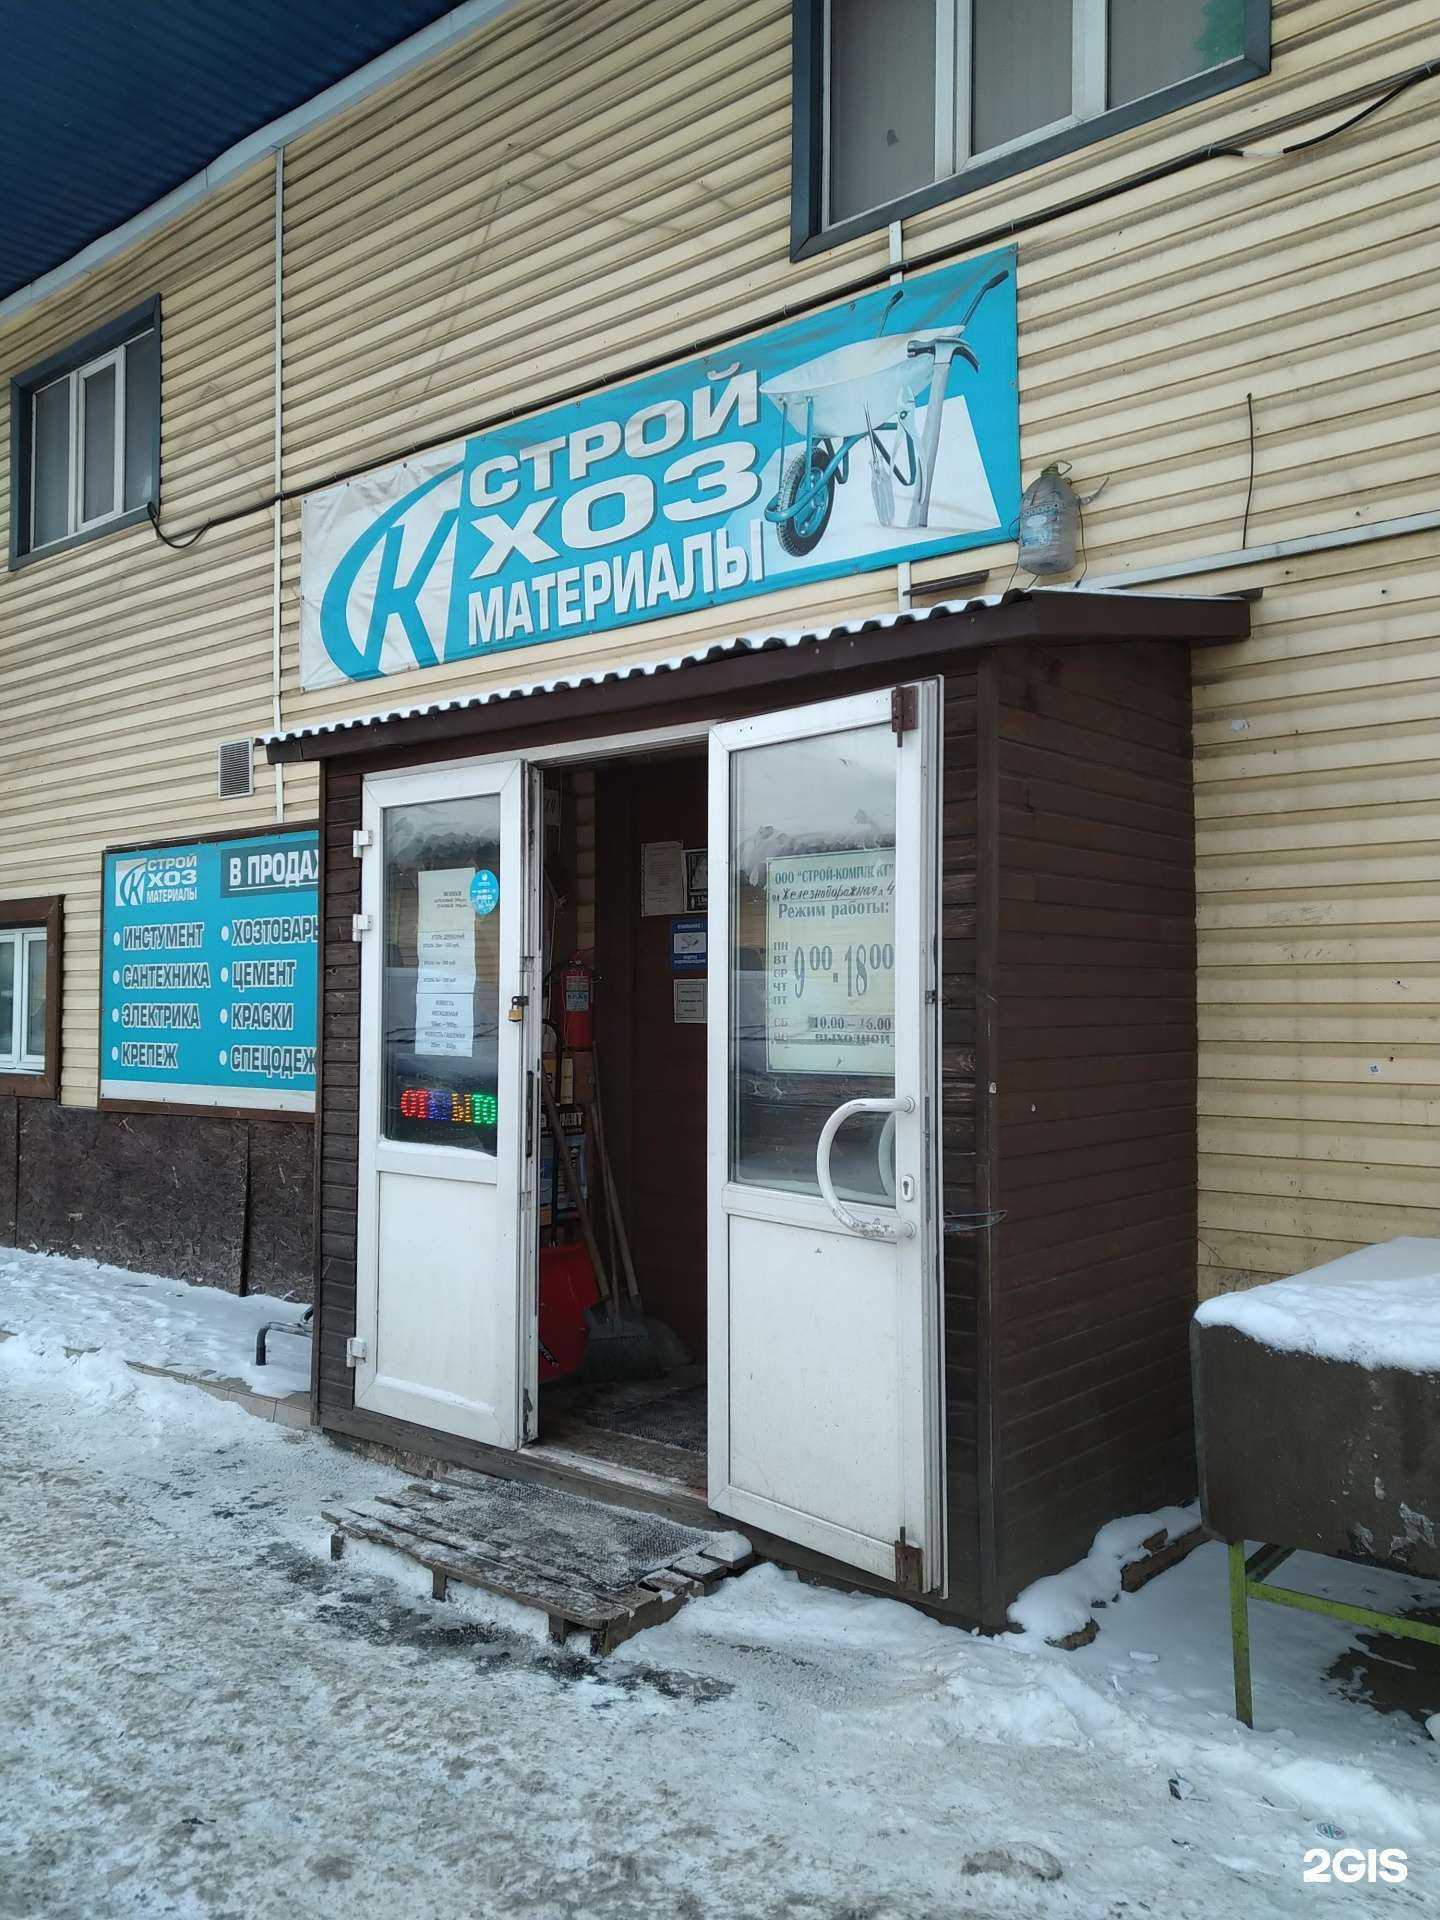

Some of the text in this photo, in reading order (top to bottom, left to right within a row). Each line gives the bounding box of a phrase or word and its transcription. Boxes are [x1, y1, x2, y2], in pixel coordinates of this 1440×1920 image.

[470, 362, 760, 508] СТРОЙ
[470, 442, 763, 579] ХОЗ
[469, 518, 765, 646] МАТЕРИАЛЫ
[147, 853, 198, 872] СТРОЙ
[230, 857, 242, 887] В
[147, 870, 198, 888] ХОЗ
[774, 871, 795, 885] ООО
[146, 886, 198, 904] МАТЕРИАЛЫ
[778, 900, 889, 919] Режим работы:
[123, 922, 205, 951] ИНСТУМЕНТ
[773, 955, 788, 965] ВТ
[123, 962, 212, 990] САНТЕХНИКА
[232, 960, 297, 993] ЦЕМЕНТ
[772, 982, 788, 992] ЧТ
[121, 1002, 202, 1029] ЭЛЕКТРИКА
[231, 1003, 294, 1031] КРАСКИ
[121, 1042, 179, 1069] КРЕПЕЖ
